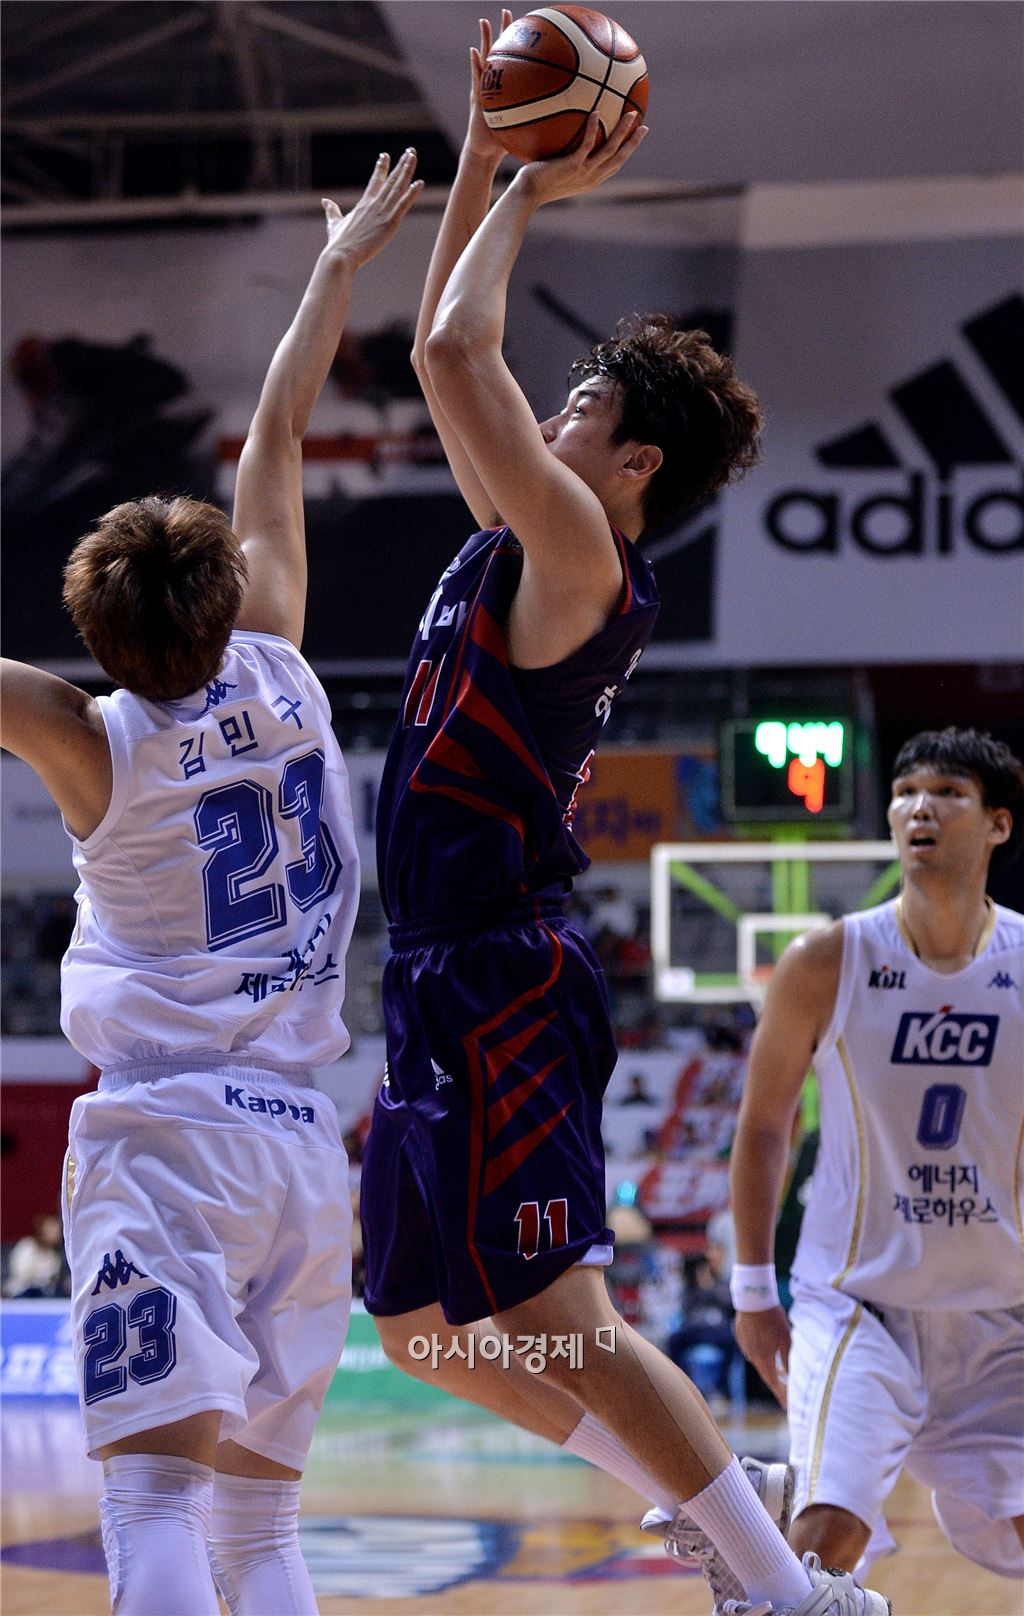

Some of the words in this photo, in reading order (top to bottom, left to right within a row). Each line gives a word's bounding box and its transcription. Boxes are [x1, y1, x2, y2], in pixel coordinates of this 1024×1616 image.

[179, 694, 303, 780] 김민구
[193, 748, 343, 953] 23
[902, 1006, 990, 1062] KCC
[917, 1082, 968, 1151] 0
[893, 1193, 999, 1227] 제로하우스
[907, 1164, 979, 1194] 에너지
[513, 1198, 569, 1261] 11
[83, 1286, 178, 1406] 23
